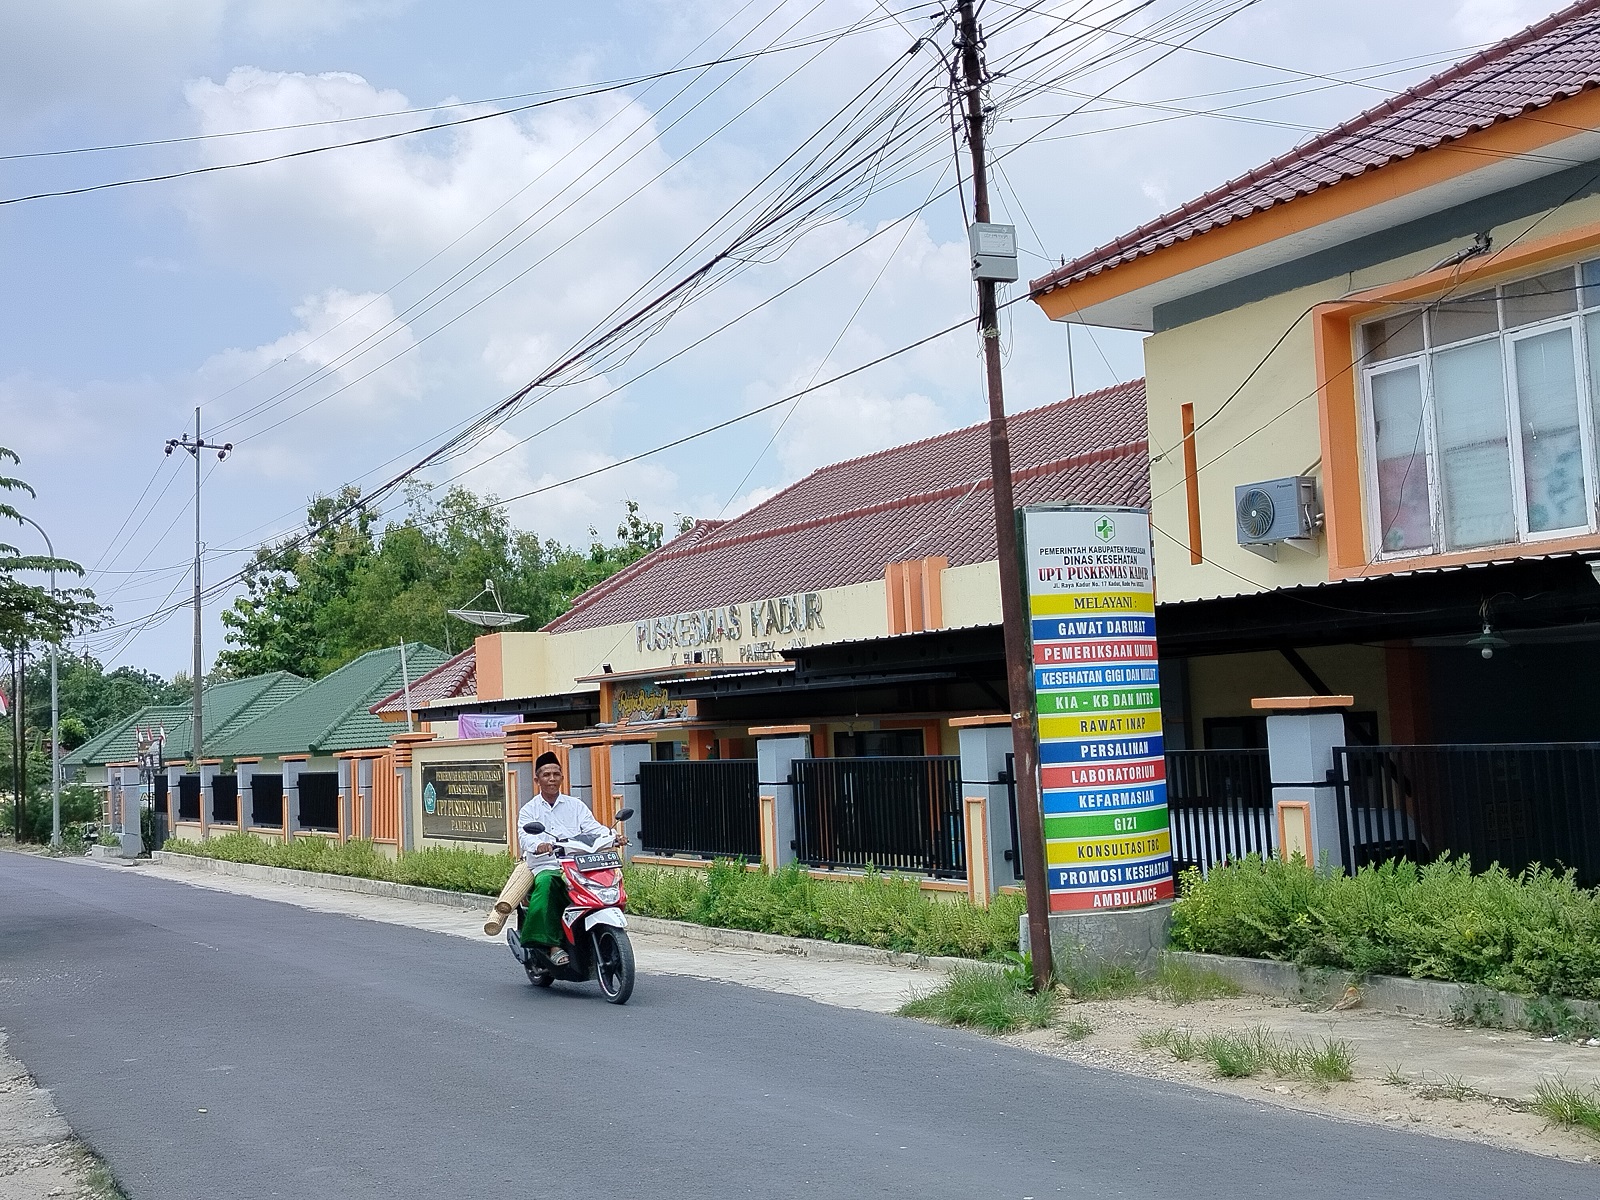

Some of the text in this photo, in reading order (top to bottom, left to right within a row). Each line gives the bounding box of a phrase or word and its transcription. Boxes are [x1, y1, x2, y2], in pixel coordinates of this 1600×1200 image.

[1040, 547, 1087, 556] PEMERINTAH
[1088, 546, 1124, 554] KABUPATEN
[1063, 555, 1138, 566] DINAS KESEHATAN
[1038, 566, 1149, 582] UPT PUSKESMAS KADUR
[1074, 597, 1132, 609] MELAYANI
[635, 592, 825, 653] PUSKESMAS KADUR
[1058, 621, 1146, 636] GAWAT DARURAT
[1044, 644, 1153, 660] PEMERIKSAAN UMUM
[1042, 670, 1103, 685] KESEHATAN
[1105, 669, 1124, 682] GIGI
[1126, 669, 1140, 681] DAN
[1056, 696, 1079, 710] KIA
[1093, 695, 1109, 707] KB
[1113, 694, 1134, 707] DAN
[1136, 693, 1154, 705] MTBS
[1080, 717, 1146, 733] RAWAT INAP
[1081, 741, 1149, 758] PERSALINAN
[1071, 765, 1155, 784] LABORATORIUM
[1079, 790, 1155, 808] KEFARMASIAN
[451, 820, 487, 833] PAMEKASAN
[1114, 817, 1137, 831] GIZI
[1078, 838, 1159, 859] KONSULTASI TBC
[1060, 861, 1169, 885] PROMOSI KESEHATAN
[1093, 887, 1157, 907] AMBULANCE
